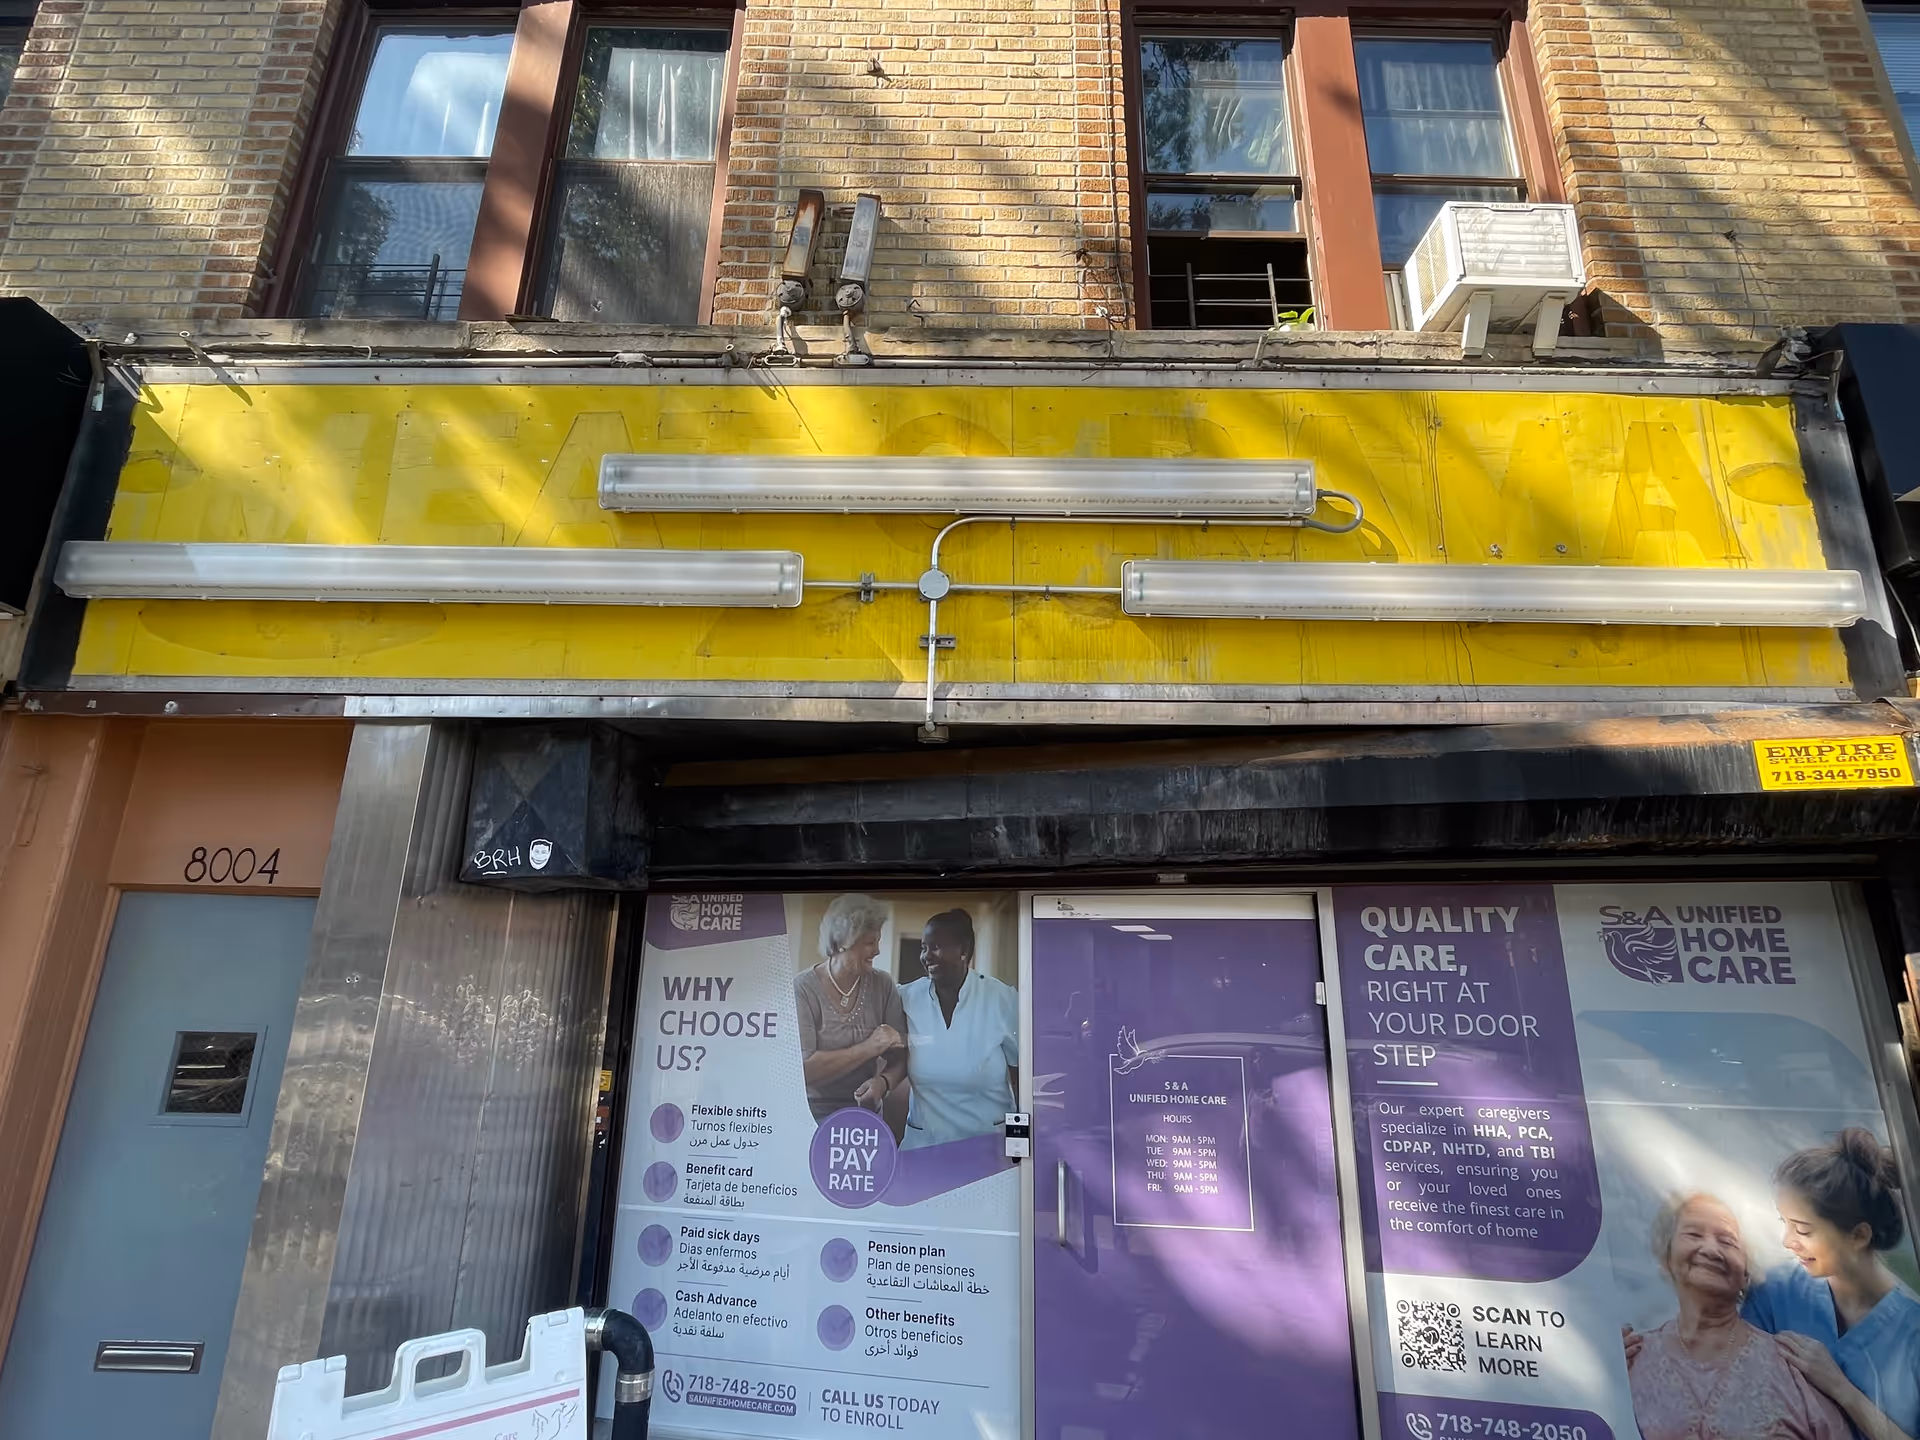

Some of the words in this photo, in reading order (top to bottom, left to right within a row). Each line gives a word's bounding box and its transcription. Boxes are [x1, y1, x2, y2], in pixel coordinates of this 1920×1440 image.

[1764, 743, 1897, 758] EMPIRE
[1836, 754, 1895, 762] GATES
[1772, 768, 1901, 781] 718-344-7950
[184, 846, 281, 884] 8004
[702, 894, 743, 902] UNIFIED
[701, 904, 742, 916] HOME
[1599, 906, 1673, 926] S&A
[1676, 906, 1782, 924] UNIFIED
[700, 917, 741, 930] CARE
[1360, 906, 1519, 938] QUALITY
[1681, 928, 1789, 953] HOME
[1364, 945, 1468, 976] CARE,
[1688, 956, 1796, 984] CARE
[663, 976, 734, 1002] WHY
[1368, 981, 1447, 1002] RIGHT
[1457, 982, 1489, 1003] AT
[659, 1010, 778, 1038] CHOOSE
[1368, 1012, 1446, 1035] YOUR
[1455, 1014, 1540, 1037] DOOR
[656, 1045, 707, 1071] US?
[1373, 1044, 1436, 1066] STEP
[1165, 1082, 1170, 1090] S
[1172, 1082, 1179, 1090] &
[1181, 1082, 1188, 1090] A
[1130, 1094, 1168, 1103] UNIFIED
[1170, 1095, 1199, 1104] HOME
[1201, 1096, 1226, 1105] CARE
[691, 1105, 733, 1116] Flexible
[736, 1107, 767, 1118] shifts
[1163, 1115, 1192, 1123] HOURS
[1379, 1103, 1404, 1115] Our
[1419, 1104, 1464, 1119] expert
[1478, 1106, 1550, 1121] caregivers
[691, 1120, 726, 1132] Turnos
[729, 1122, 773, 1134] flexibles
[1381, 1122, 1447, 1136] specialize
[1454, 1125, 1466, 1136] in
[1473, 1125, 1511, 1139] HHA,
[1519, 1126, 1553, 1141] PCA,
[689, 1137, 707, 1147] مرن
[710, 1136, 731, 1148] عمل
[734, 1138, 759, 1149] جدول
[830, 1127, 878, 1146] HIGH
[1146, 1135, 1168, 1143] MON:
[1172, 1136, 1191, 1144] 9AM
[1147, 1147, 1163, 1155] TUE:
[1173, 1148, 1191, 1156] 9AM
[1198, 1149, 1216, 1157] 5PM
[1383, 1140, 1436, 1155] CDPAP,
[1443, 1143, 1491, 1158] NHTD,
[1497, 1146, 1524, 1158] and
[1530, 1146, 1556, 1159] TBI
[829, 1147, 878, 1171] PAY
[1147, 1159, 1168, 1167] WED:
[1173, 1160, 1192, 1168] 9AM
[1199, 1161, 1217, 1169] 5PM
[686, 1163, 725, 1175] Benefit
[728, 1166, 753, 1177] card
[1147, 1171, 1166, 1179] THU:
[1173, 1173, 1193, 1181] 9AM
[1199, 1173, 1217, 1181] 5PM
[1385, 1161, 1444, 1175] services,
[1456, 1164, 1519, 1180] ensuring
[1531, 1167, 1558, 1181] you
[686, 1179, 721, 1193] Tarjeta
[725, 1182, 738, 1193] de
[741, 1183, 798, 1196] beneficios
[829, 1173, 874, 1192] RATE
[1148, 1184, 1162, 1192] FRI:
[1174, 1185, 1193, 1193] 9AM
[1200, 1185, 1218, 1194] 5PM
[1387, 1180, 1401, 1191] or
[1419, 1181, 1450, 1195] your
[1469, 1182, 1507, 1196] loved
[1526, 1187, 1561, 1199] ones
[683, 1194, 716, 1206] المنفعة
[720, 1196, 745, 1210] بطاقة
[1388, 1199, 1438, 1212] receive
[1442, 1202, 1465, 1214] the
[1470, 1202, 1510, 1217] finest
[1515, 1207, 1545, 1218] care
[1551, 1207, 1564, 1219] in
[681, 1226, 704, 1238] Paid
[708, 1228, 730, 1241] sick
[733, 1231, 760, 1245] days
[1390, 1218, 1413, 1231] the
[1417, 1220, 1473, 1235] comfort
[1478, 1223, 1491, 1235] of
[1496, 1223, 1538, 1238] home
[706, 1246, 757, 1259] enfermos
[868, 1241, 916, 1255] Pension
[919, 1245, 946, 1258] plan
[701, 1262, 735, 1275] مدفوعة
[739, 1266, 770, 1278] مرضية
[868, 1258, 892, 1271] Plan
[896, 1260, 911, 1272] de
[914, 1263, 975, 1277] pensiones
[867, 1274, 910, 1288] التقاعدية
[913, 1280, 963, 1292] المعاشات
[967, 1281, 990, 1295] خطة
[675, 1290, 704, 1303] Cash
[707, 1293, 757, 1308] Advance
[674, 1307, 722, 1322] Adelanto
[726, 1312, 739, 1323] en
[743, 1314, 788, 1329] efectivo
[866, 1307, 900, 1321] Other
[904, 1310, 955, 1326] benefits
[1472, 1306, 1531, 1325] SCAN
[1537, 1310, 1565, 1328] TO
[673, 1323, 697, 1337] نقدية
[700, 1325, 725, 1339] سلفة
[865, 1325, 897, 1339] Otros
[901, 1328, 963, 1345] beneficios
[1476, 1331, 1543, 1352] LEARN
[1479, 1357, 1539, 1377] MORE
[689, 1374, 797, 1400] 718-748-2050
[689, 1394, 794, 1414] SAUNIFIEDHOMECARE.COM
[822, 1389, 859, 1406] CALL
[864, 1393, 884, 1409] US
[888, 1395, 940, 1415] TODAY
[821, 1407, 841, 1422] TO
[846, 1410, 904, 1430] ENROLL
[1437, 1413, 1587, 1440] 718-748-2050
